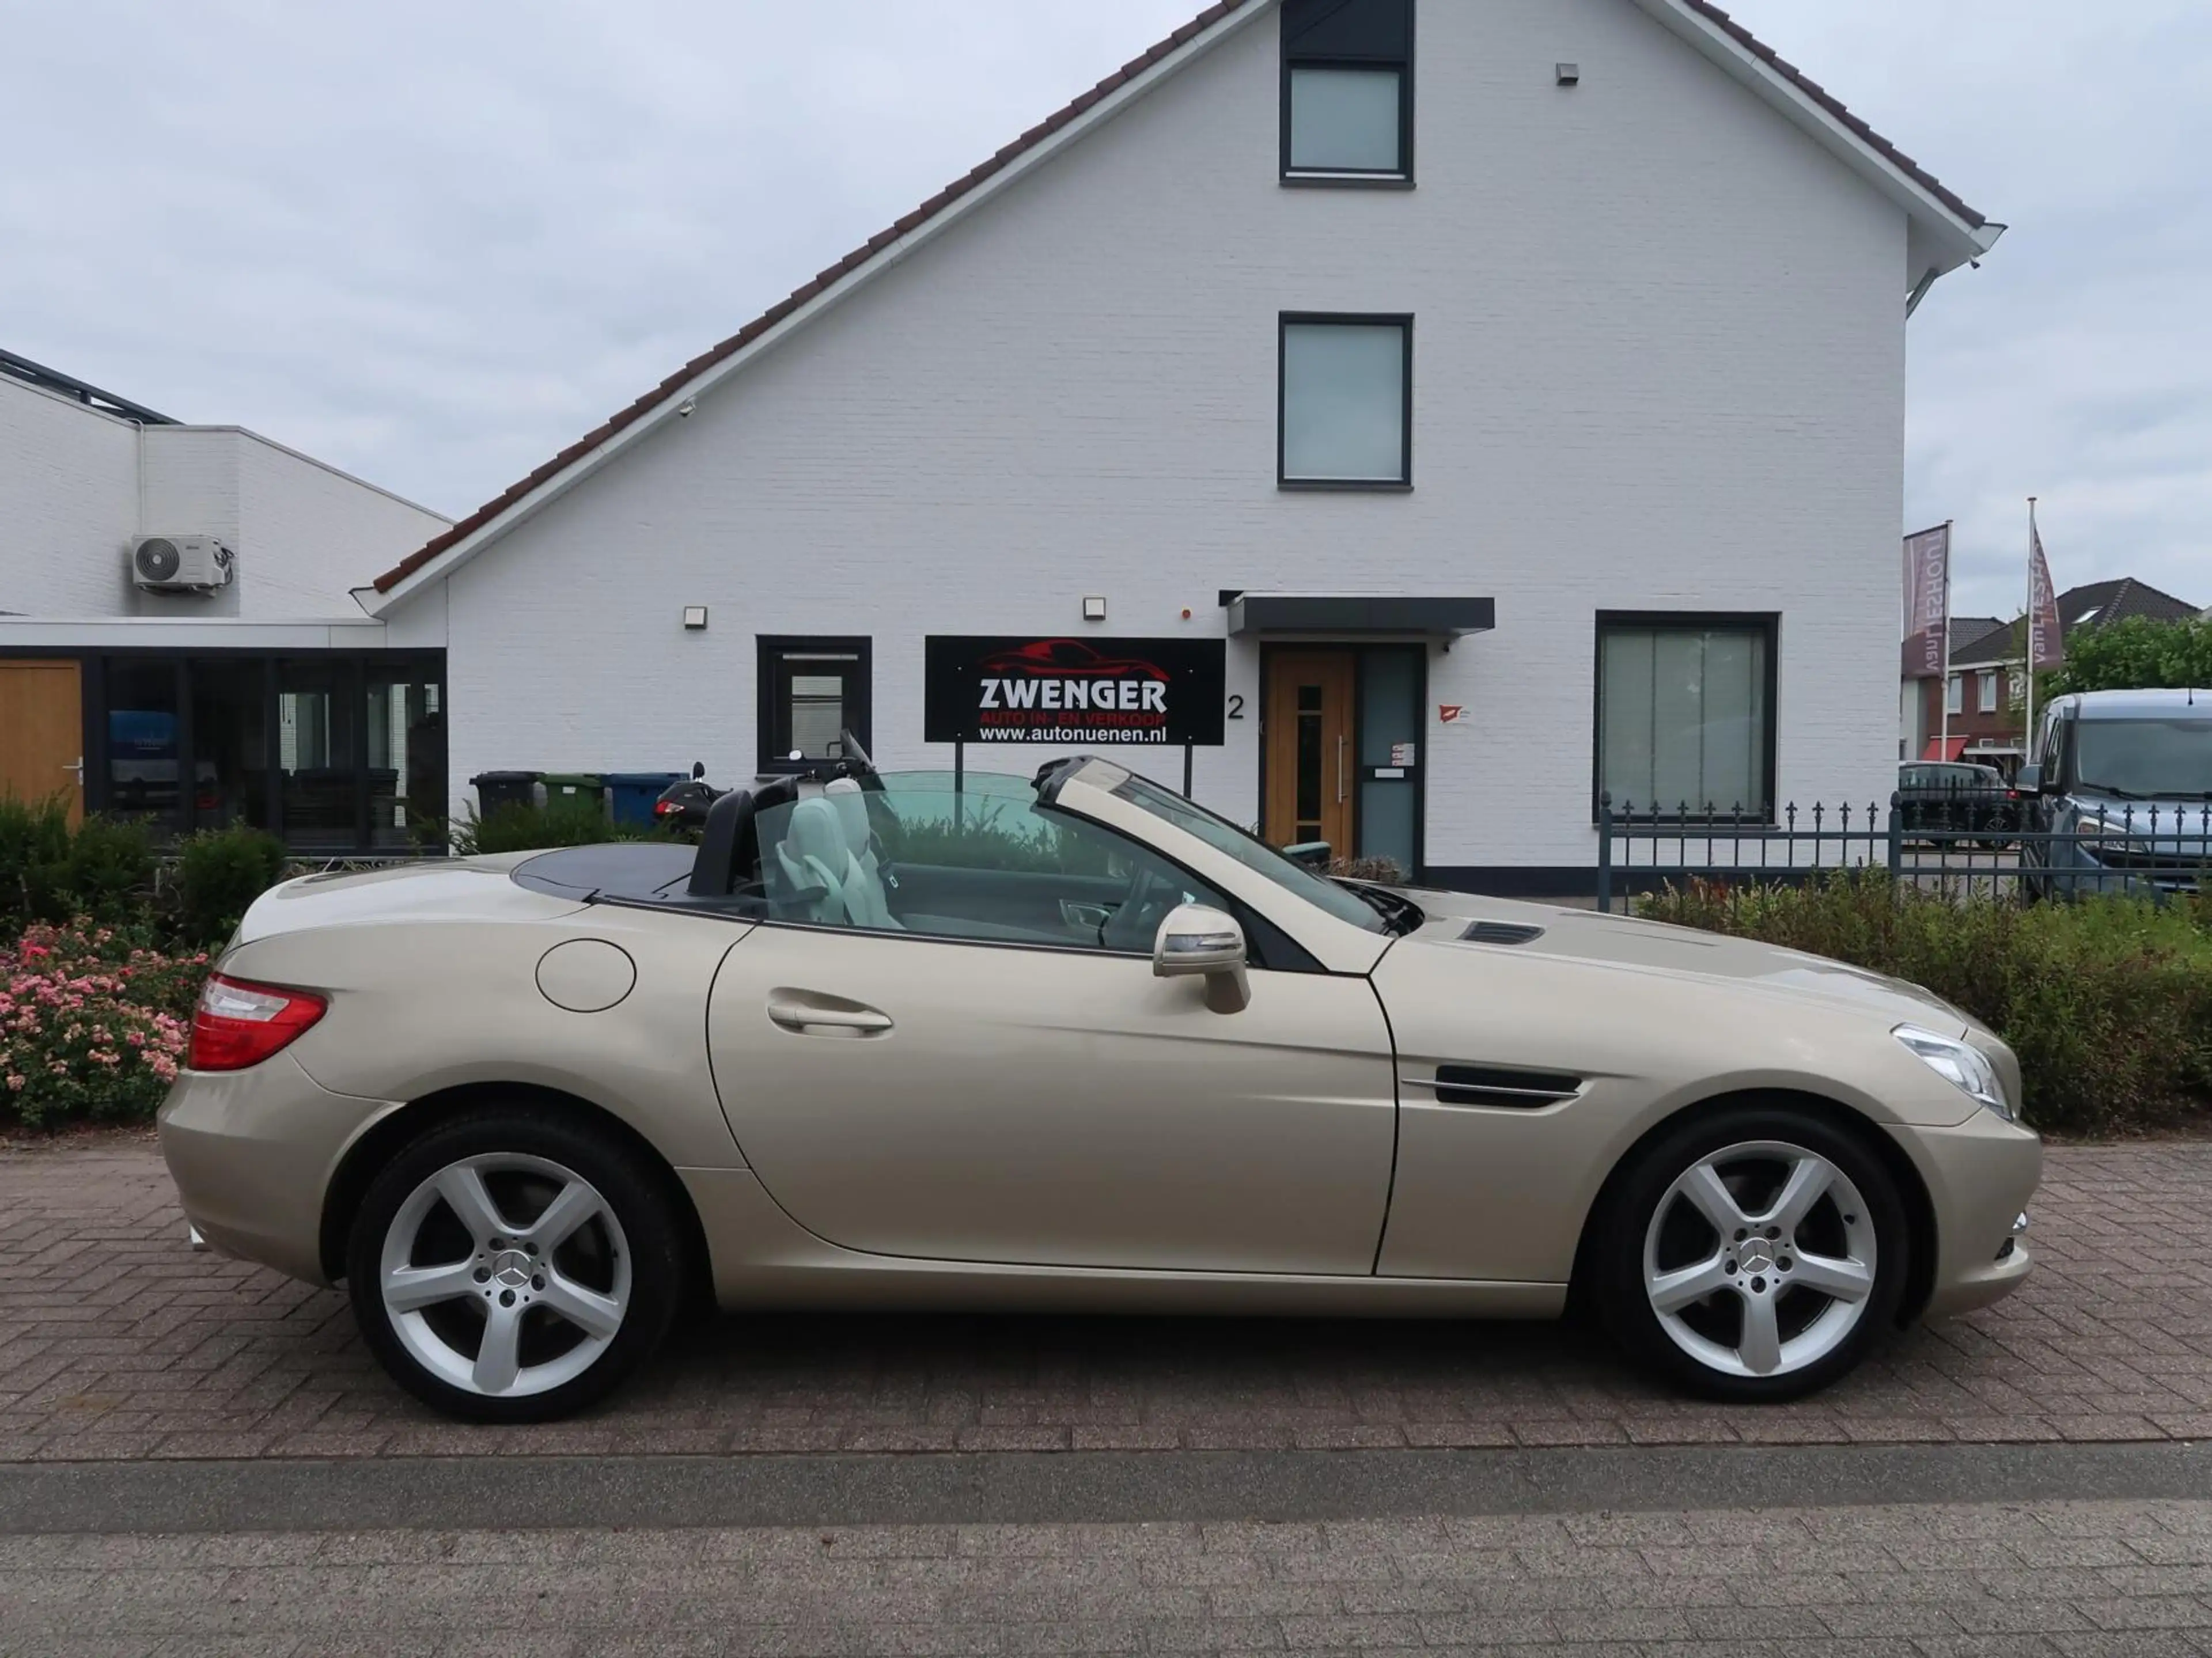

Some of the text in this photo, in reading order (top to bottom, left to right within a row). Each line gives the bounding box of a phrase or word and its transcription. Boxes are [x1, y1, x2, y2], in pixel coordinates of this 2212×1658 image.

[979, 679, 1168, 714] ZWENGER
[1228, 694, 1244, 720] 2
[981, 712, 1025, 724] AUTO
[1058, 712, 1080, 726] EN
[1086, 713, 1166, 726] VERKOOP
[980, 726, 1166, 742] www.autonuenen.nl
